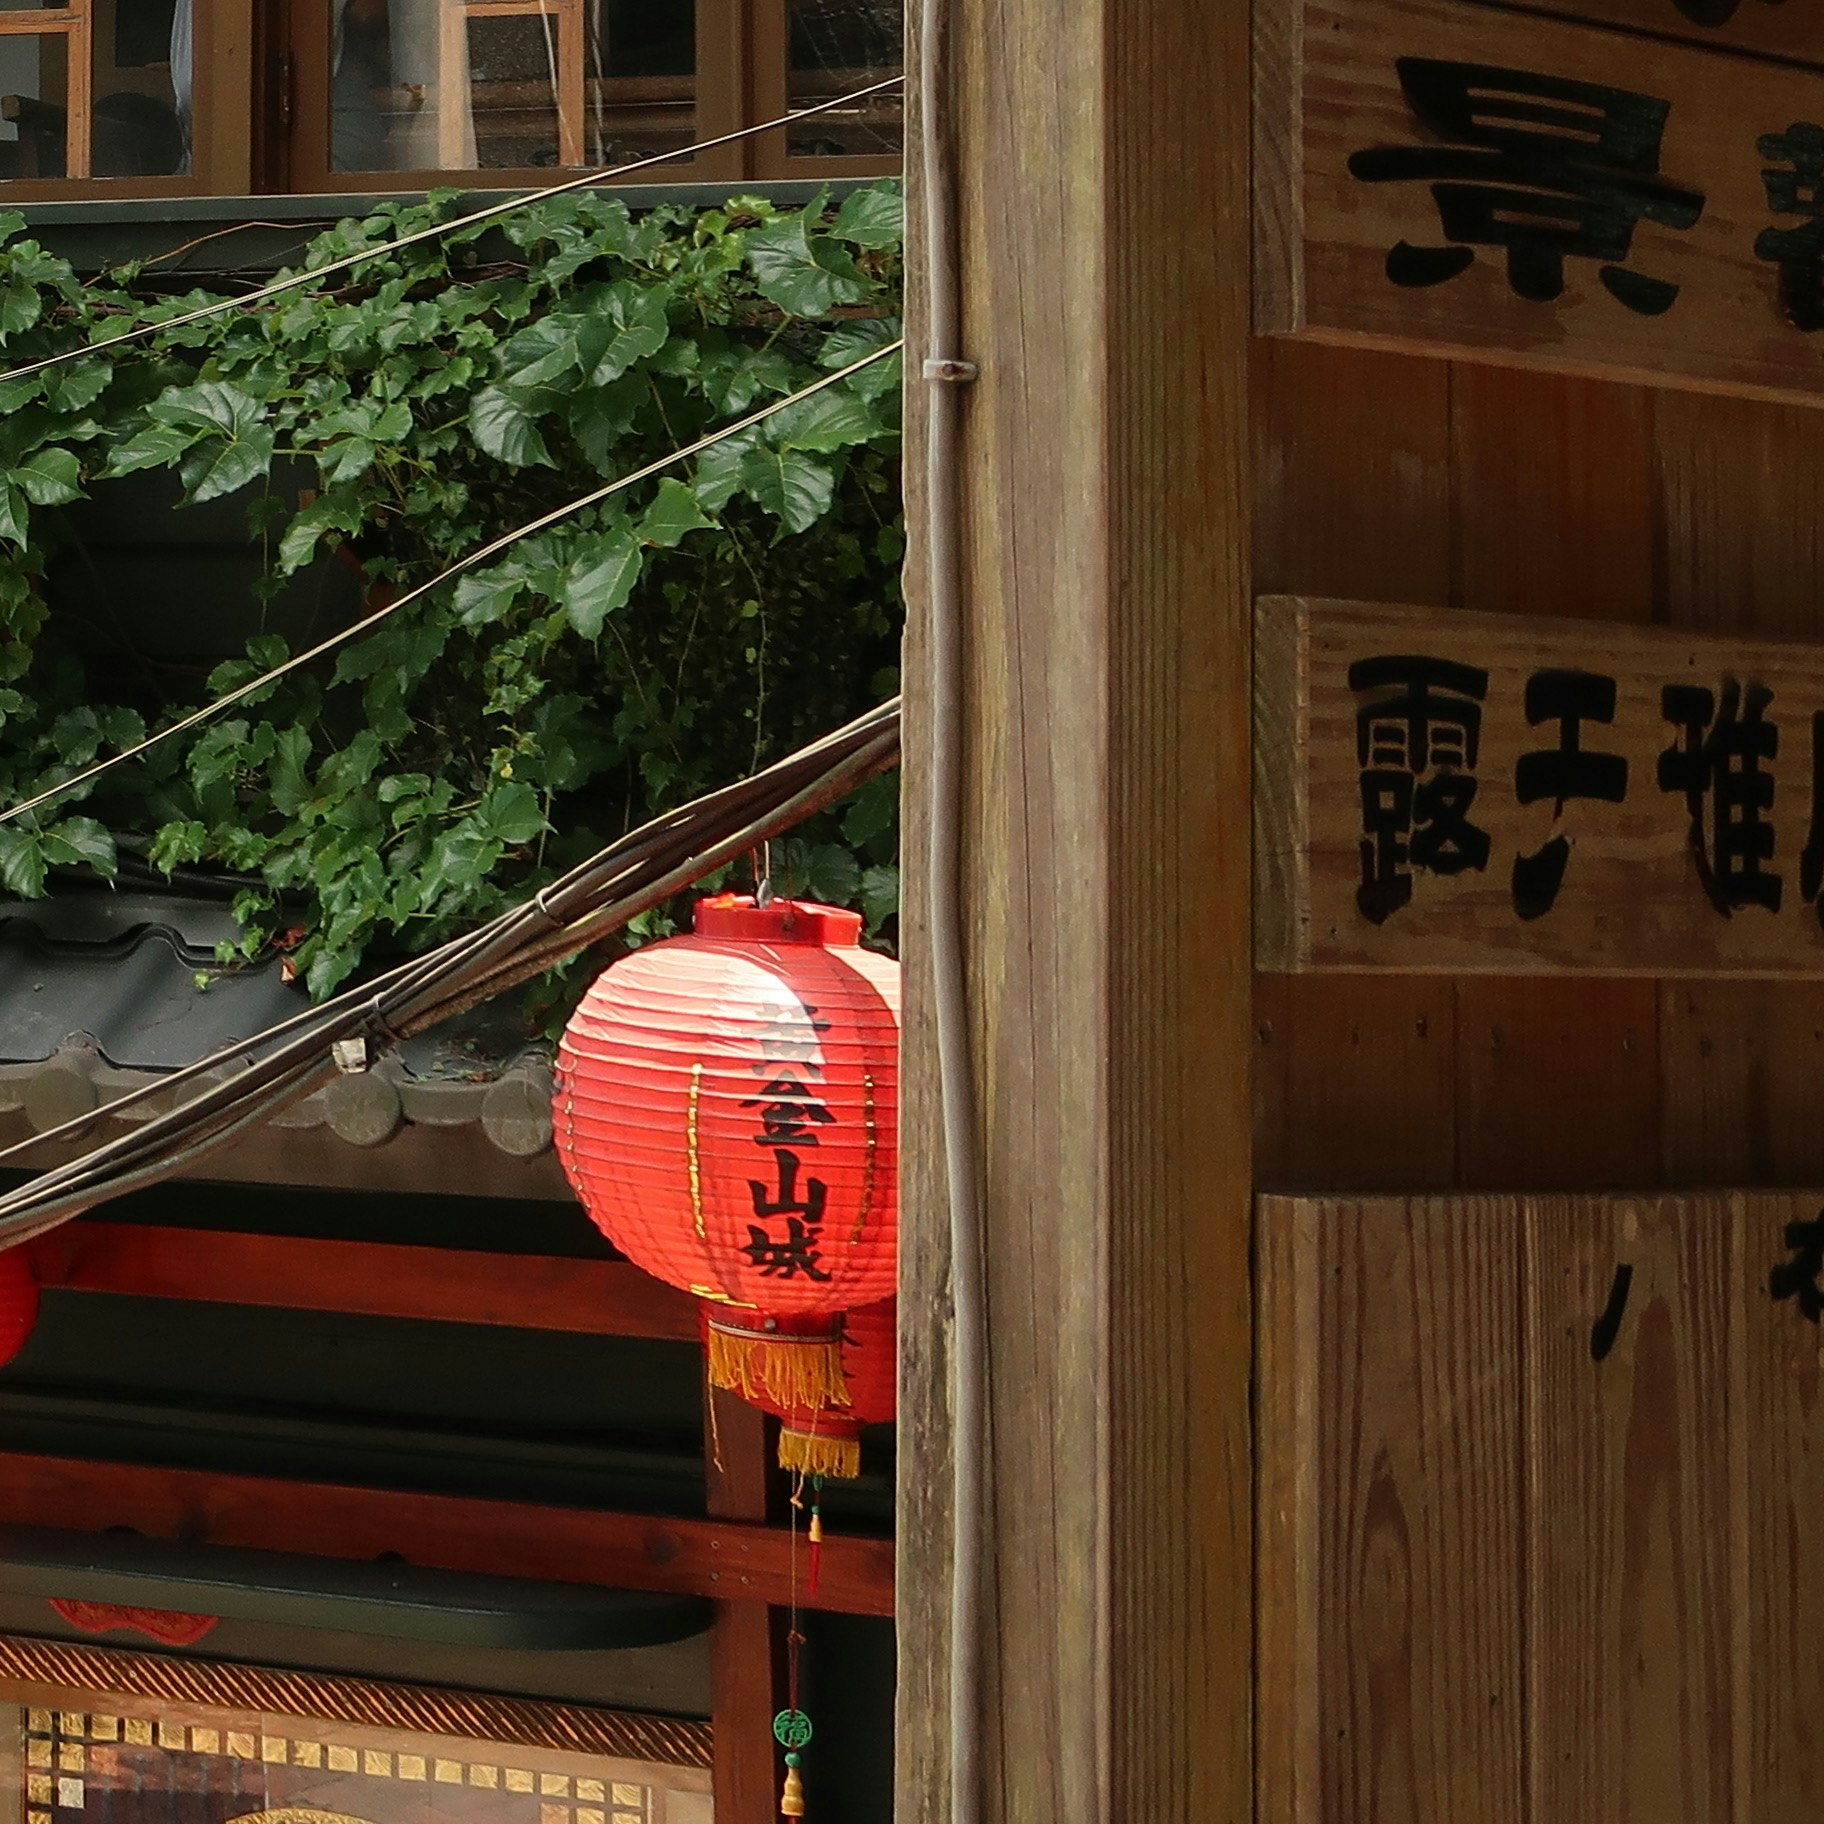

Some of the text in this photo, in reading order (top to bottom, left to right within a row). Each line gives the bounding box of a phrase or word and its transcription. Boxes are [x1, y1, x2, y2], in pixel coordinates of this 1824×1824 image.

[1347, 56, 1824, 333] 景
[1348, 654, 1824, 926] 露天雅
